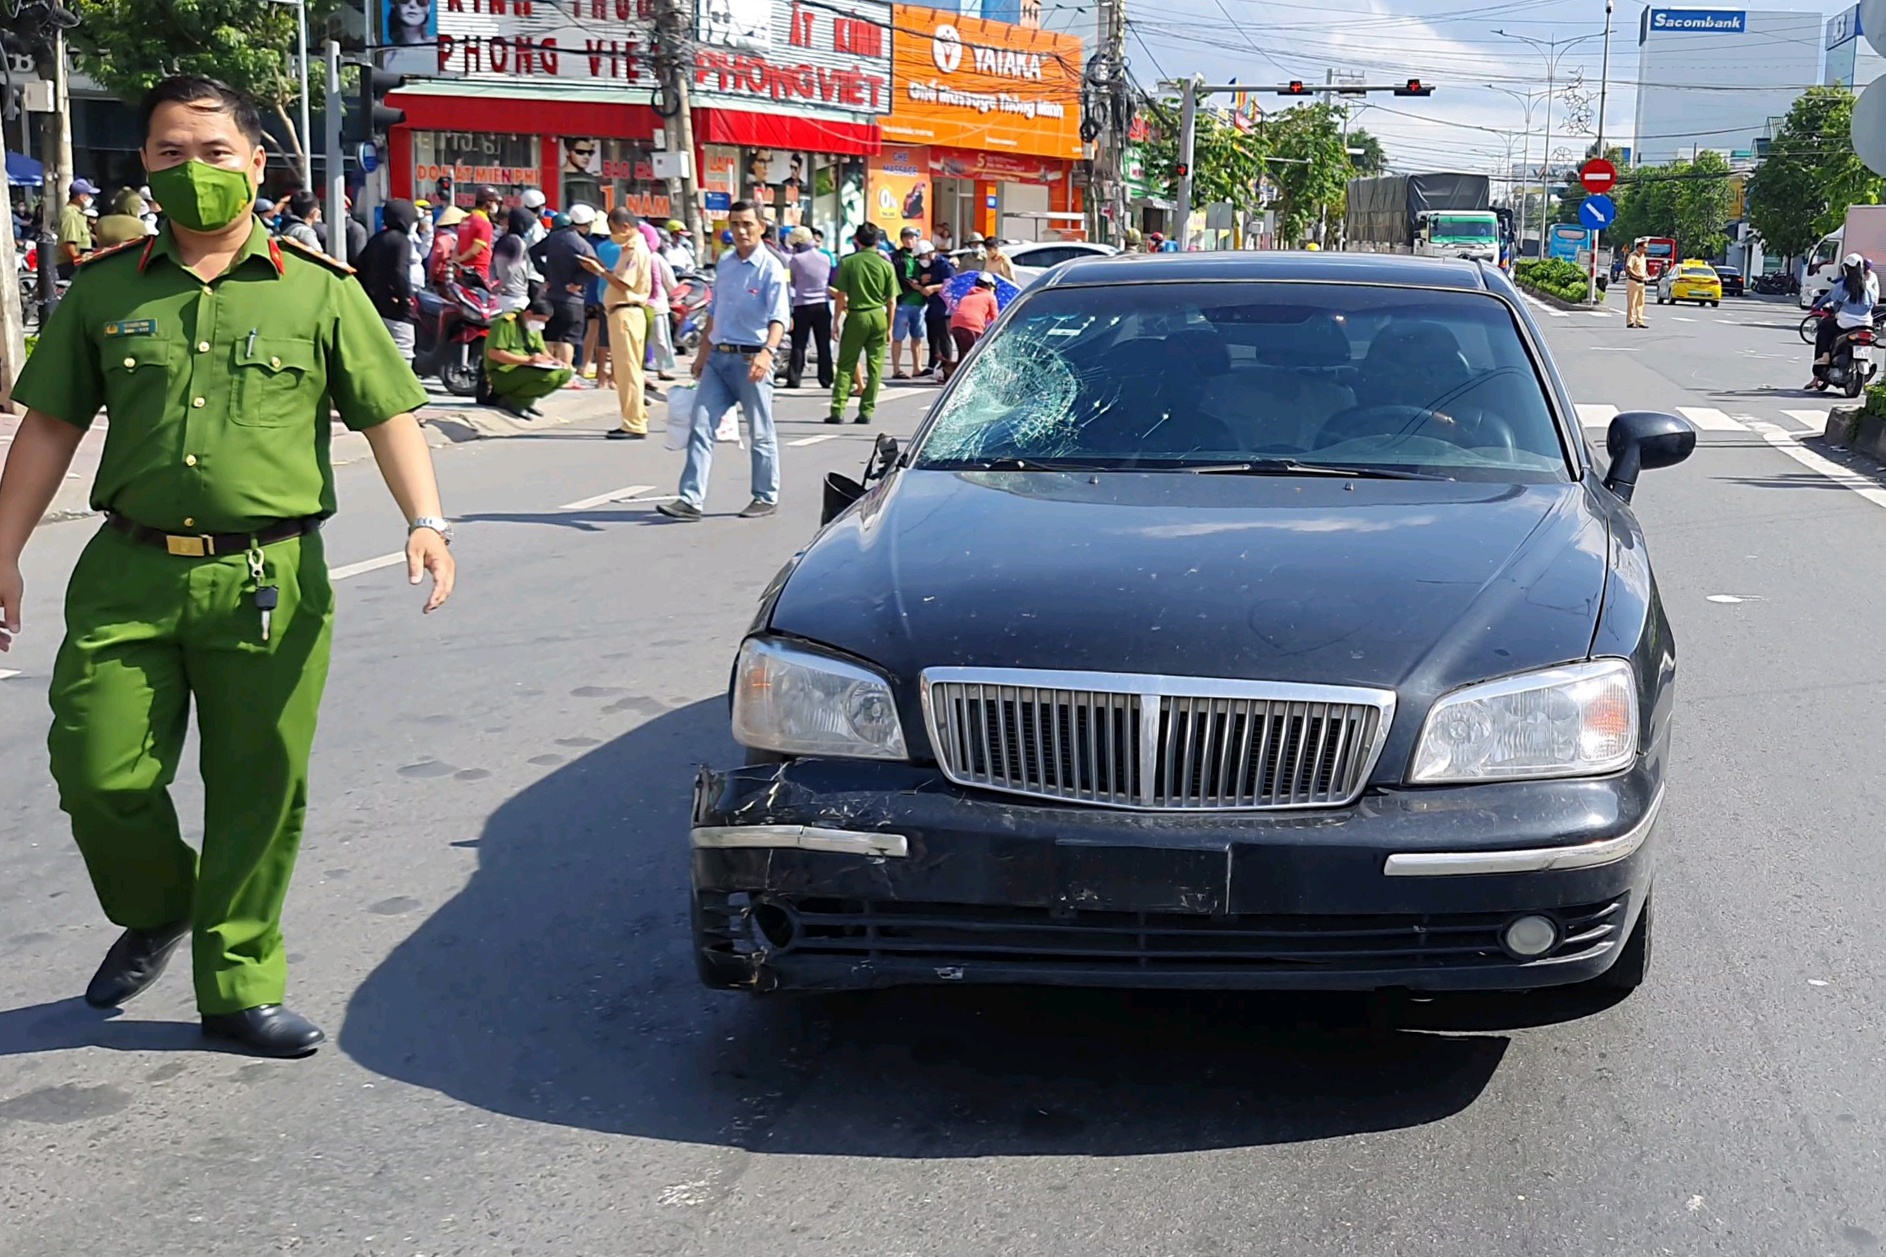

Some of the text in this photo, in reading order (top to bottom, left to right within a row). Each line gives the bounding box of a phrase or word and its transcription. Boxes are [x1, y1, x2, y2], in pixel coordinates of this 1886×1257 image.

[1654, 13, 1741, 29] Sacombank
[437, 31, 659, 85] PHONG VIỆ
[695, 51, 814, 99] PHONG
